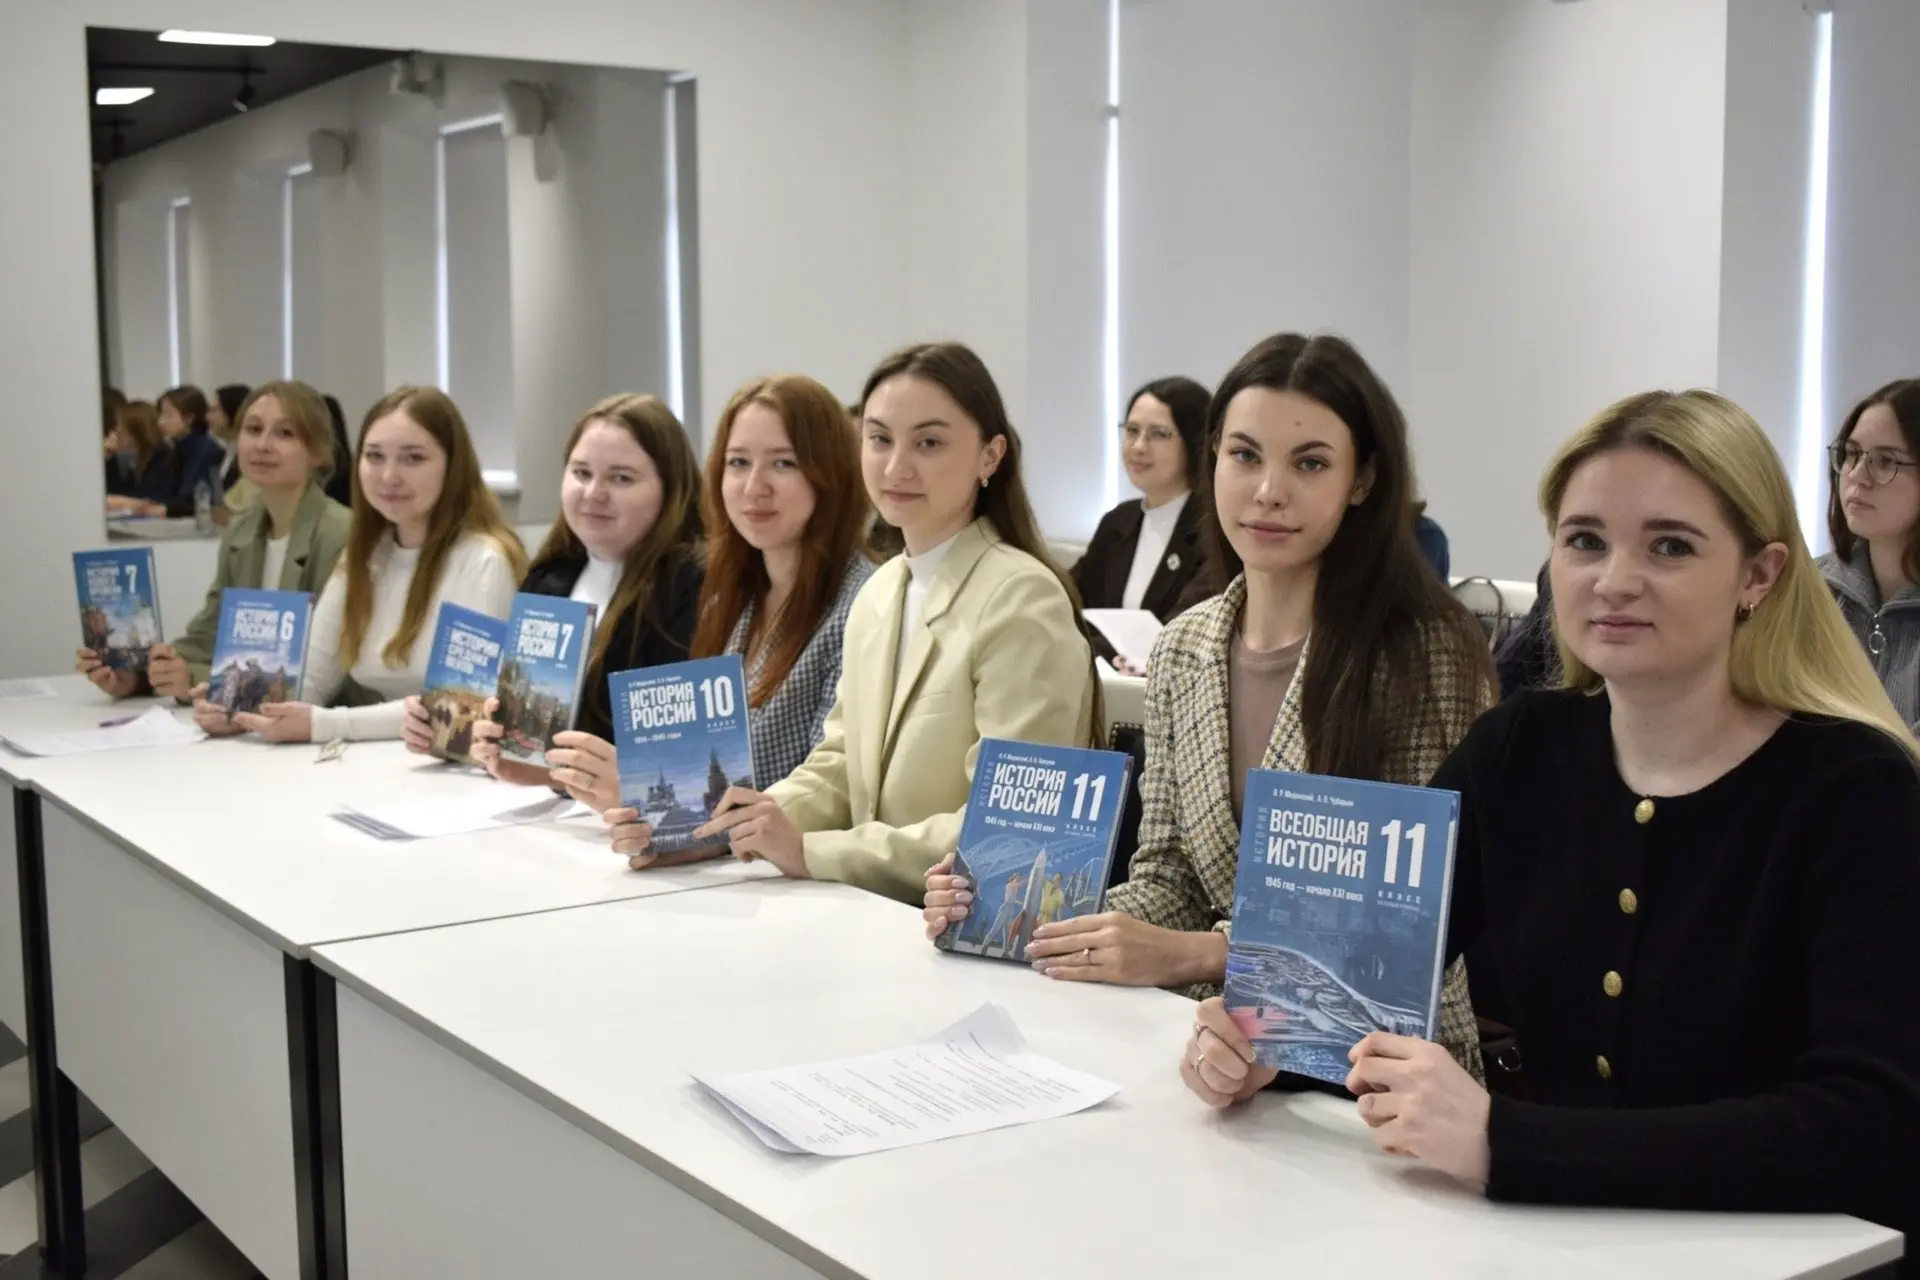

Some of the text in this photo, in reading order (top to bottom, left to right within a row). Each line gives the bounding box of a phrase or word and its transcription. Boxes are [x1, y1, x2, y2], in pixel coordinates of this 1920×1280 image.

[124, 563, 138, 595] 7
[280, 610, 296, 641] 6
[561, 623, 575, 661] 7
[629, 681, 695, 709] ИСТОРИЯ
[699, 675, 735, 719] 10
[630, 700, 697, 730] РОССИИ
[993, 762, 1067, 792] ИСТОРИЯ
[987, 784, 1062, 817] РОССИИ
[1073, 772, 1107, 822] 11
[1269, 808, 1370, 846] ВСЕОБЩАЯ
[1266, 836, 1368, 880] ИСТОРИЯ
[1380, 819, 1427, 889] 11
[1265, 875, 1282, 890] 1945
[1281, 880, 1296, 892] год
[1305, 884, 1331, 898] начало
[1345, 890, 1364, 903] века
